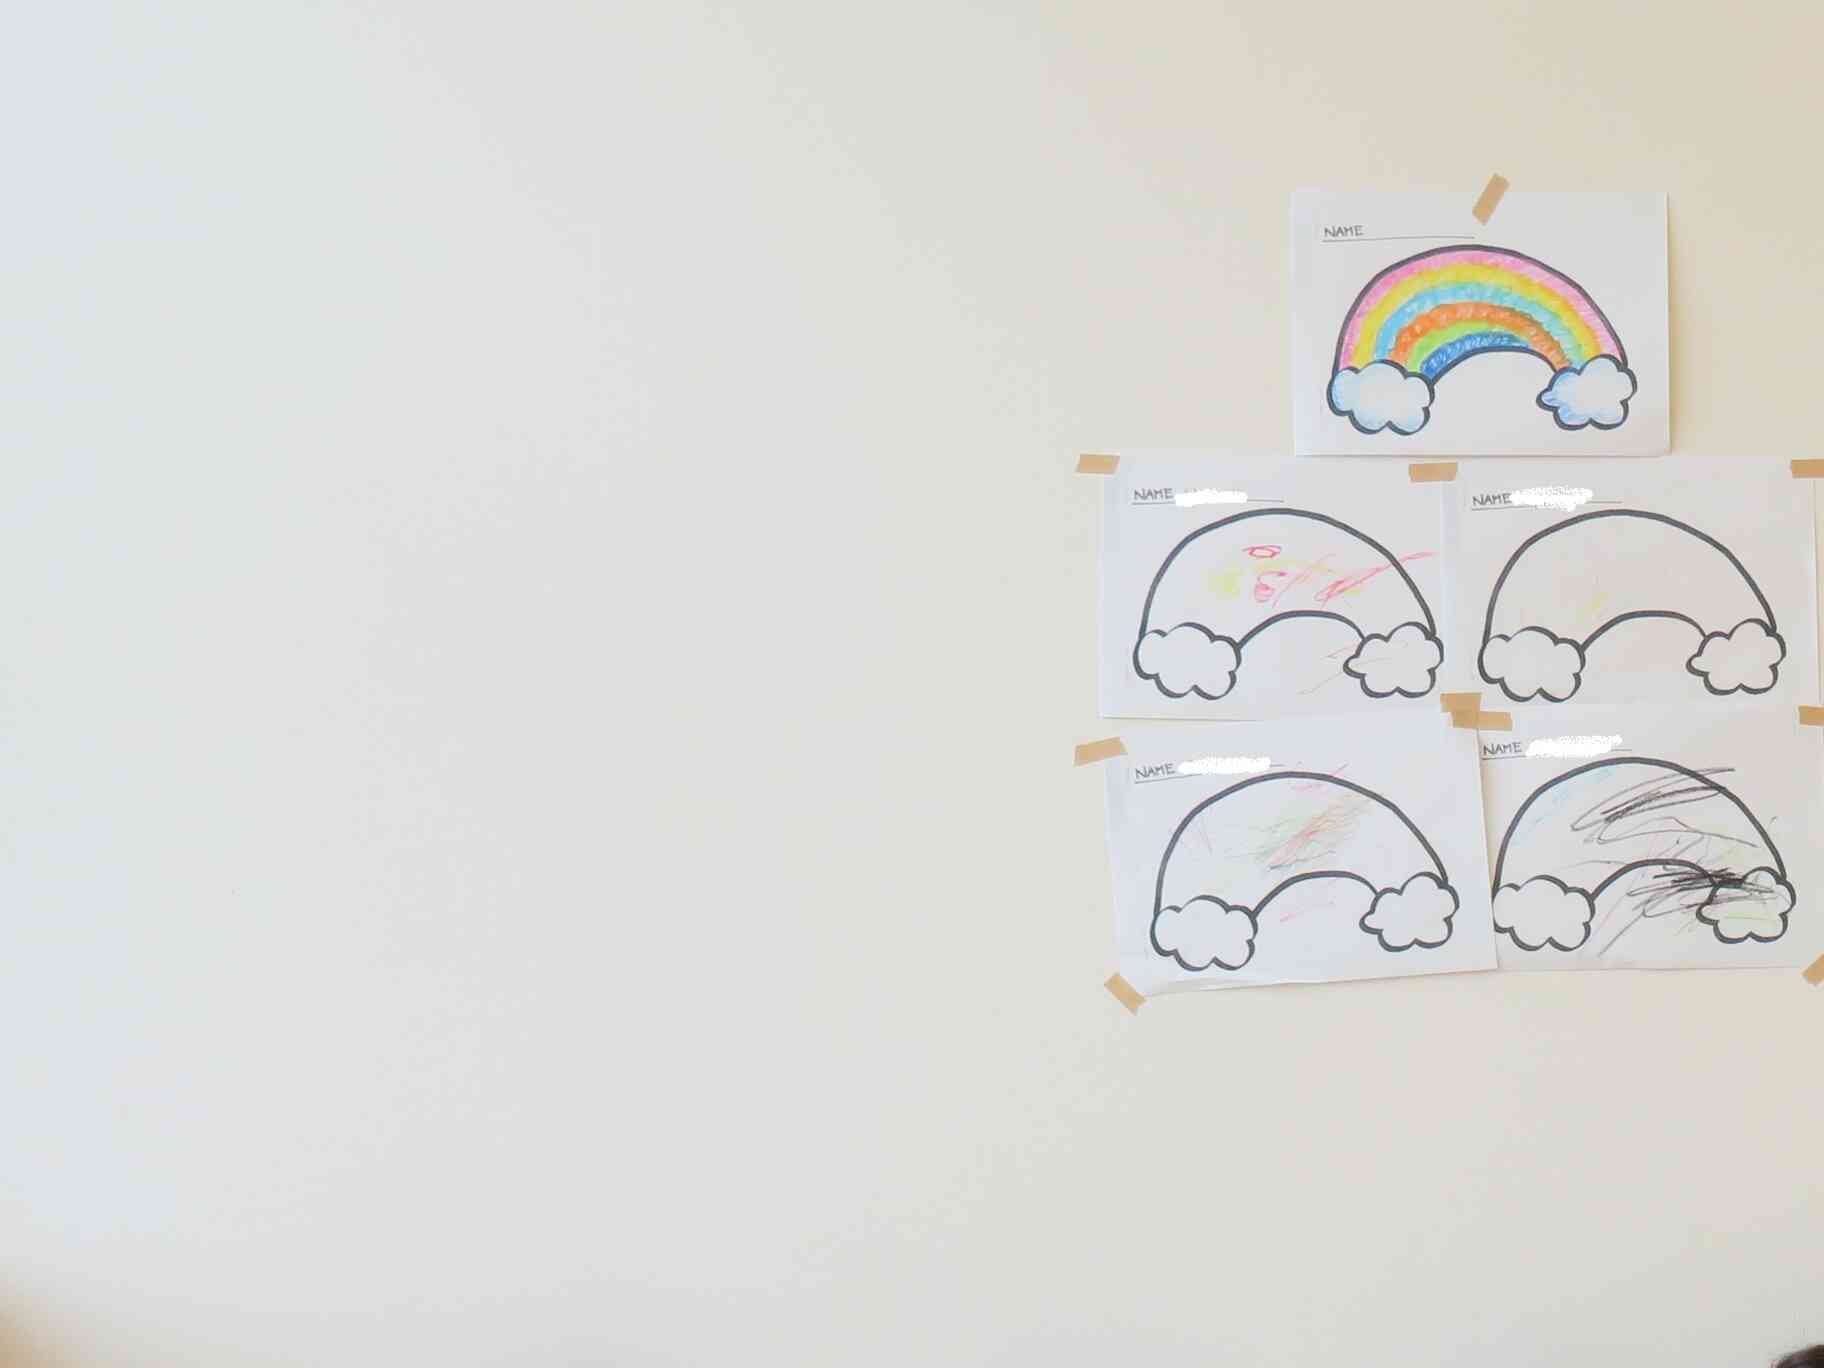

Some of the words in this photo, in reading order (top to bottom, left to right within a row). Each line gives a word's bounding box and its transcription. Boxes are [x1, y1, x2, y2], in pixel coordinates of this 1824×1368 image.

[1323, 224, 1364, 238] NAME
[1133, 487, 1174, 501] NAME
[1472, 492, 1512, 506] NAME
[1482, 741, 1523, 756] NAME
[1134, 763, 1176, 780] NAME
